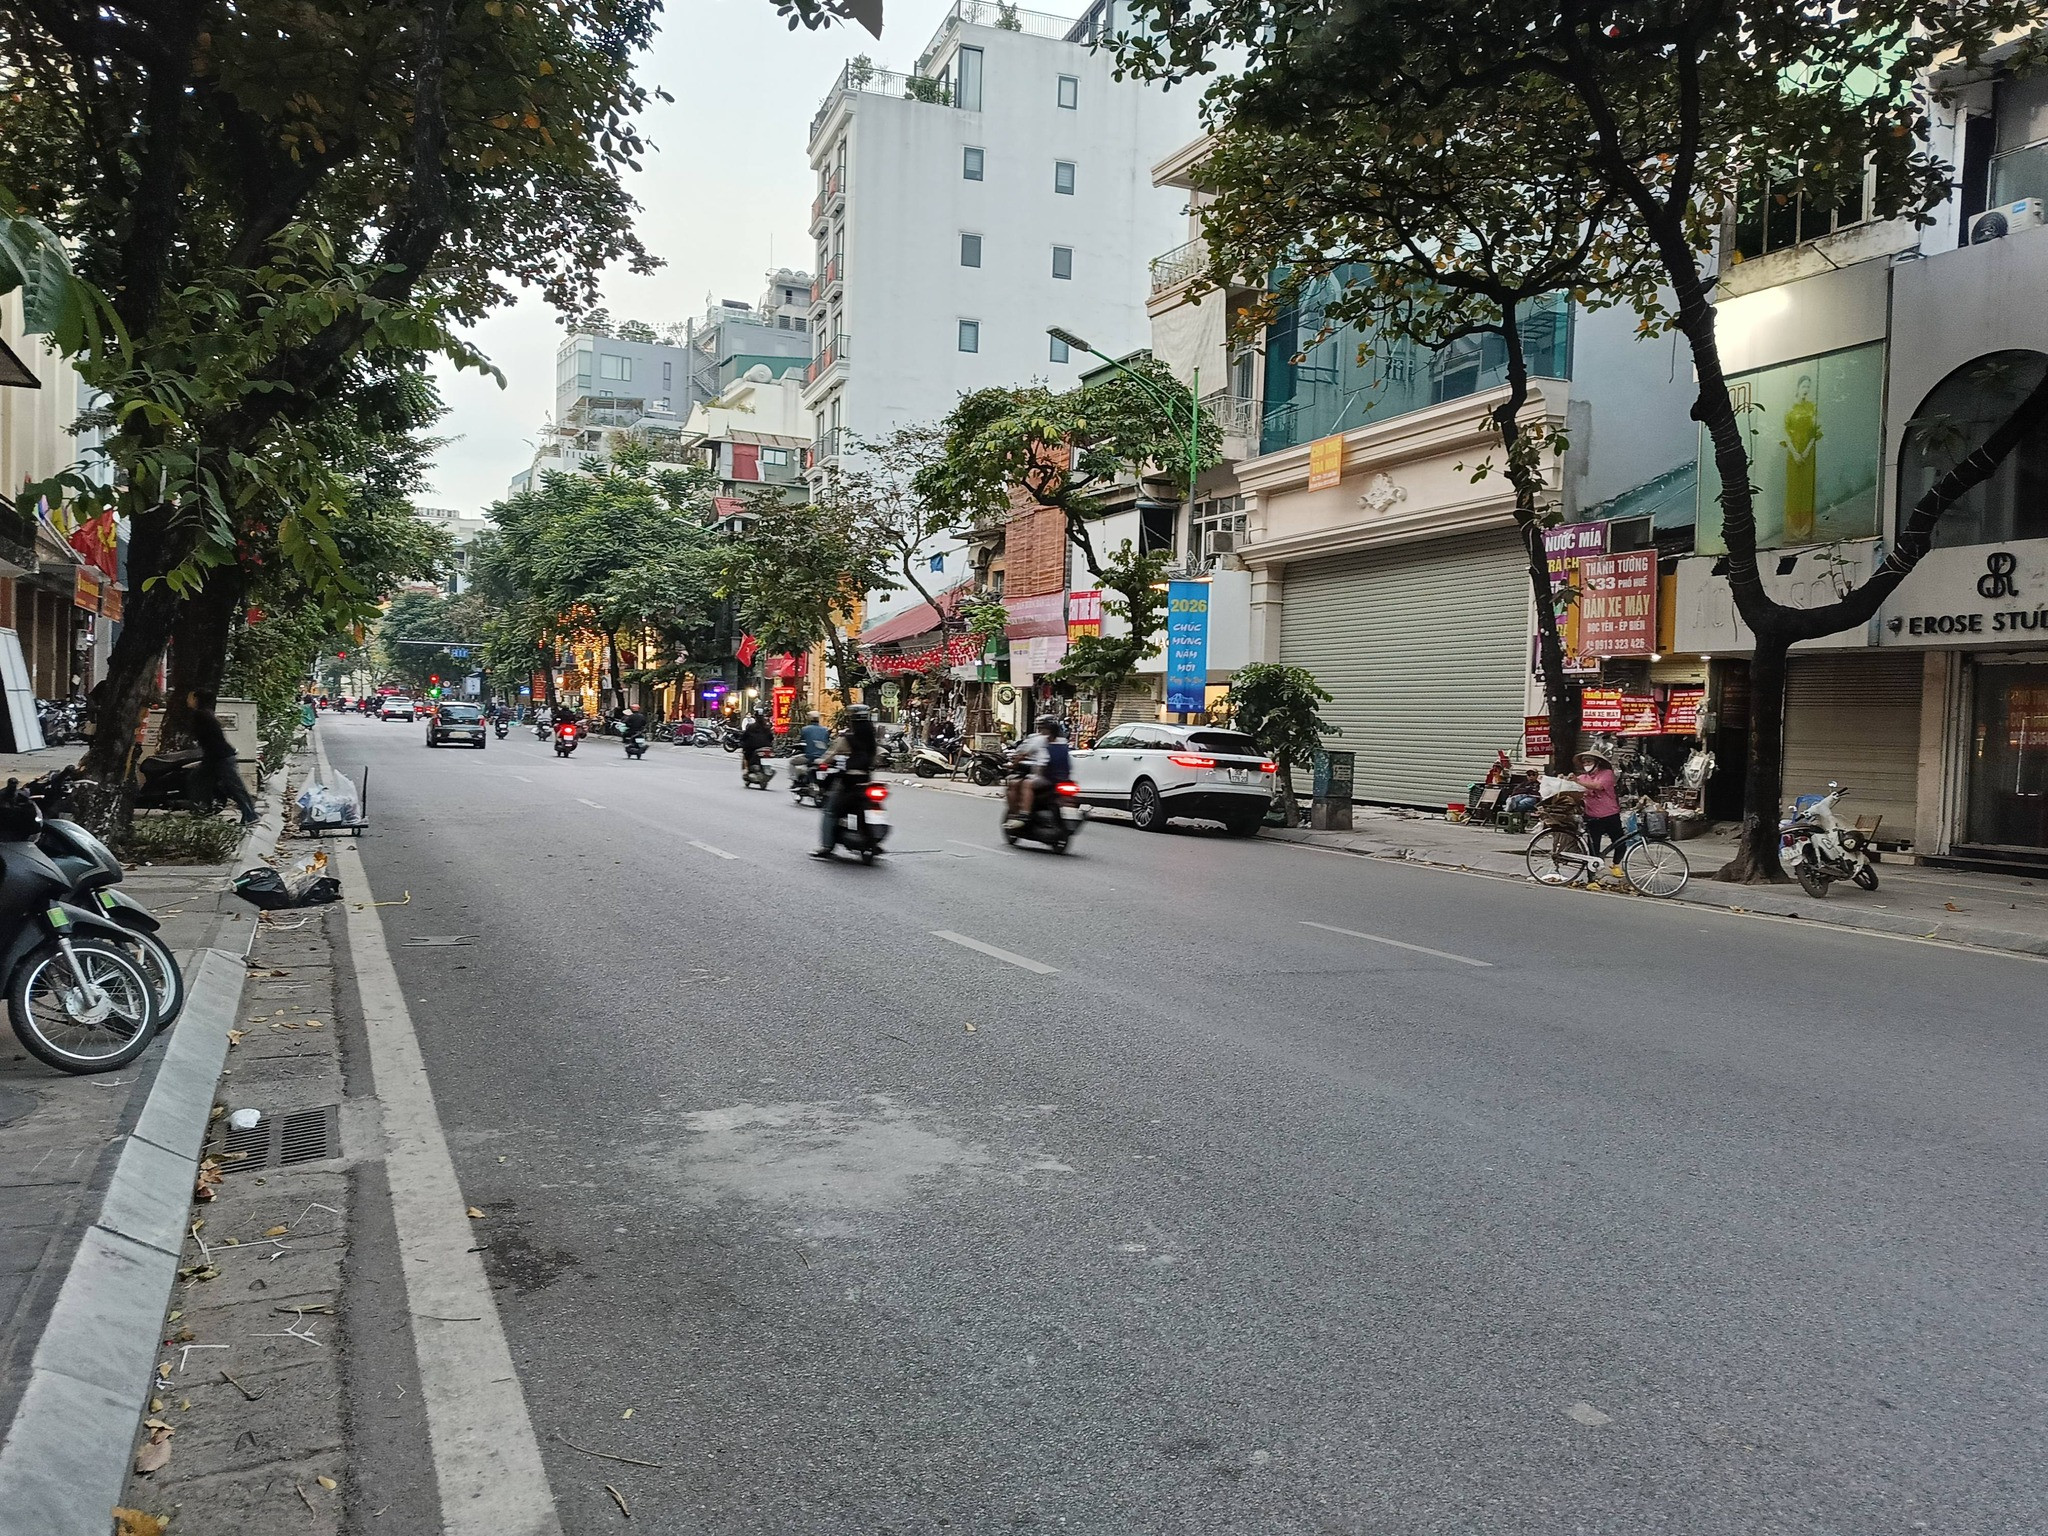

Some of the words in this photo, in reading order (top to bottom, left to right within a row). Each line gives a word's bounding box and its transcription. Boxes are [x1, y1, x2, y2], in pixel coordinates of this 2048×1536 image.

[1545, 531, 1576, 552] NƯỚC
[1579, 528, 1602, 548] MÍA
[1617, 555, 1649, 573] TƯỜNG
[1618, 576, 1632, 589] PHỐ
[1633, 575, 1648, 588] HUẾ
[1170, 599, 1208, 613] 2026
[1583, 594, 1605, 619] DÁN
[1608, 596, 1622, 618] XE
[1625, 590, 1651, 616] MÁY
[1173, 622, 1202, 632] CHÚC
[1909, 614, 1983, 634] EROSE
[1172, 634, 1202, 646] MỪNG
[1175, 648, 1198, 658] NĂM
[1177, 662, 1196, 672] MỚI
